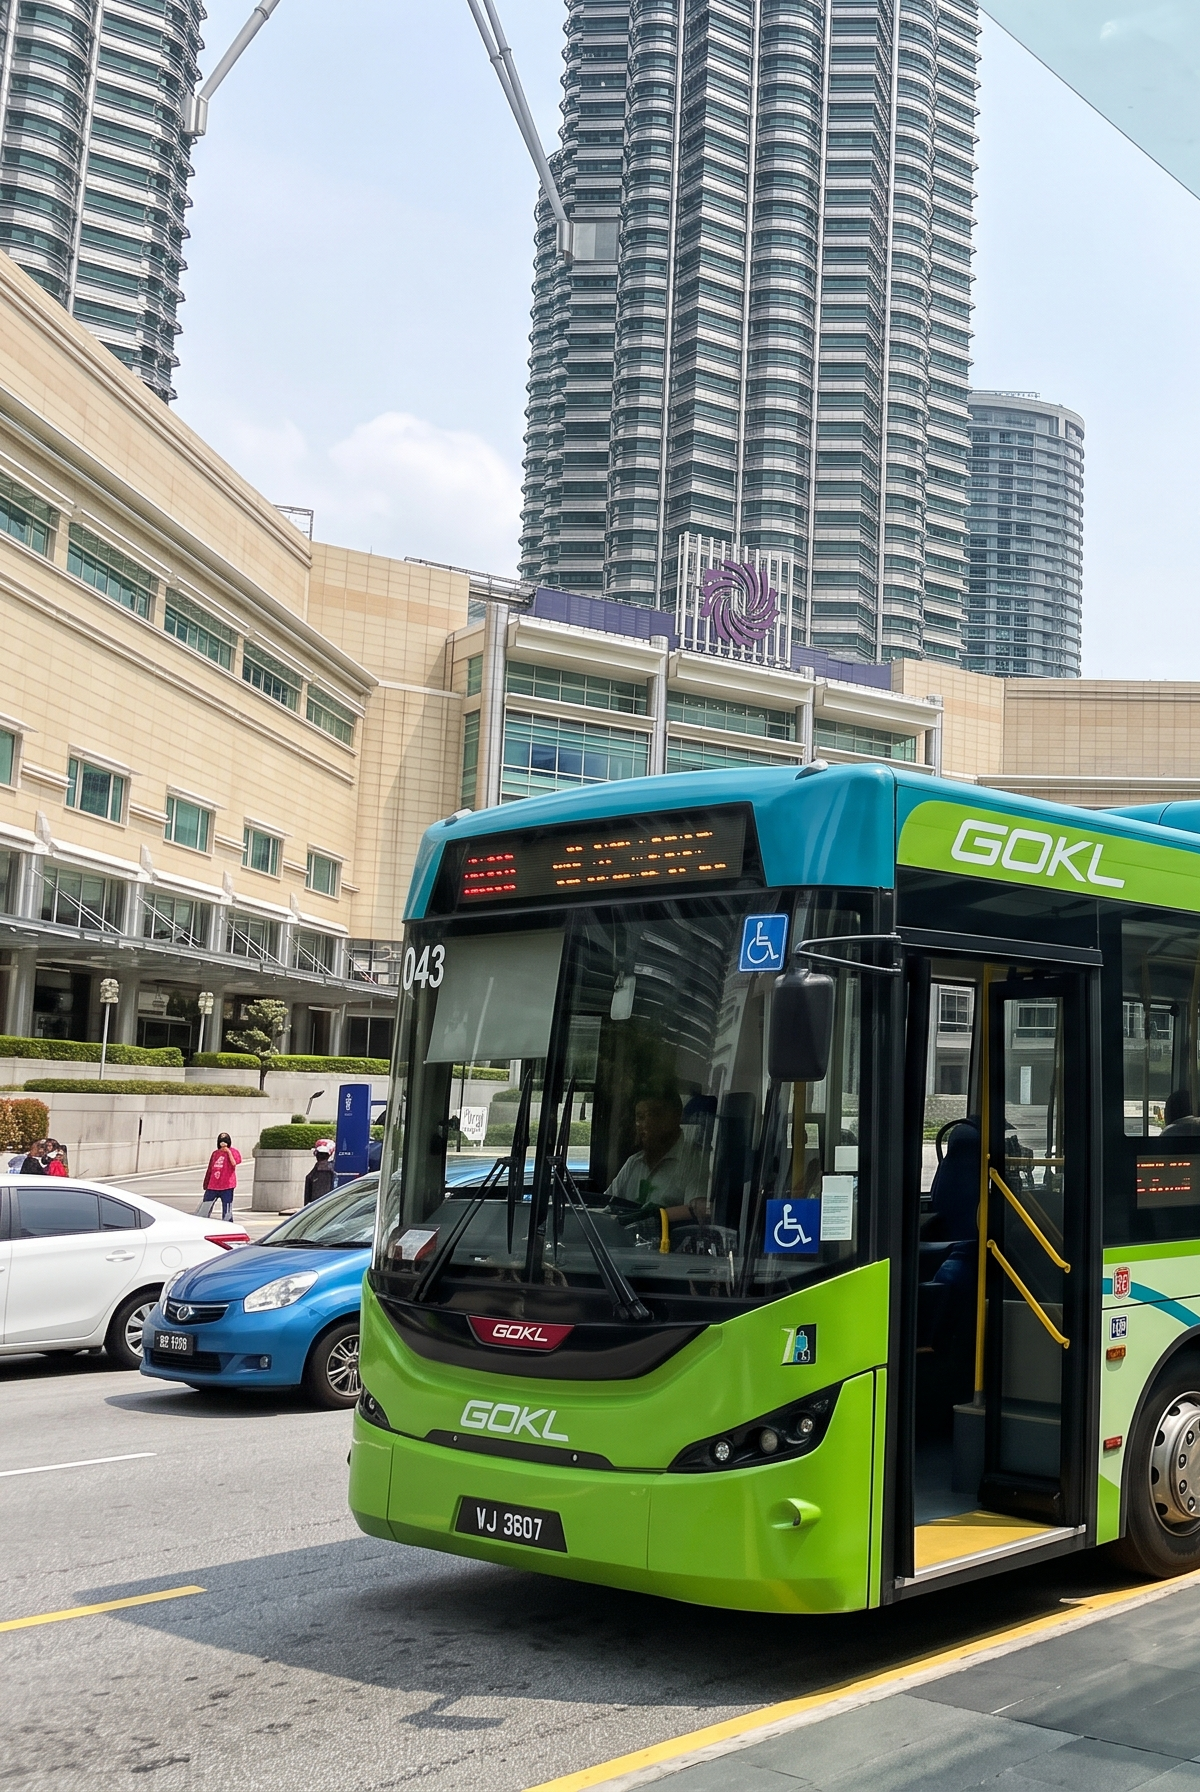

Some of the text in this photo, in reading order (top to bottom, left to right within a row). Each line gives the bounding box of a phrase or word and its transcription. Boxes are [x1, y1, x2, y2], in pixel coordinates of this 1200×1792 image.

[951, 818, 1126, 889] GOKL
[403, 944, 446, 991] 043
[492, 1323, 548, 1342] GOKL
[460, 1399, 569, 1442] GOKL
[476, 1506, 543, 1541] VJ 3607
